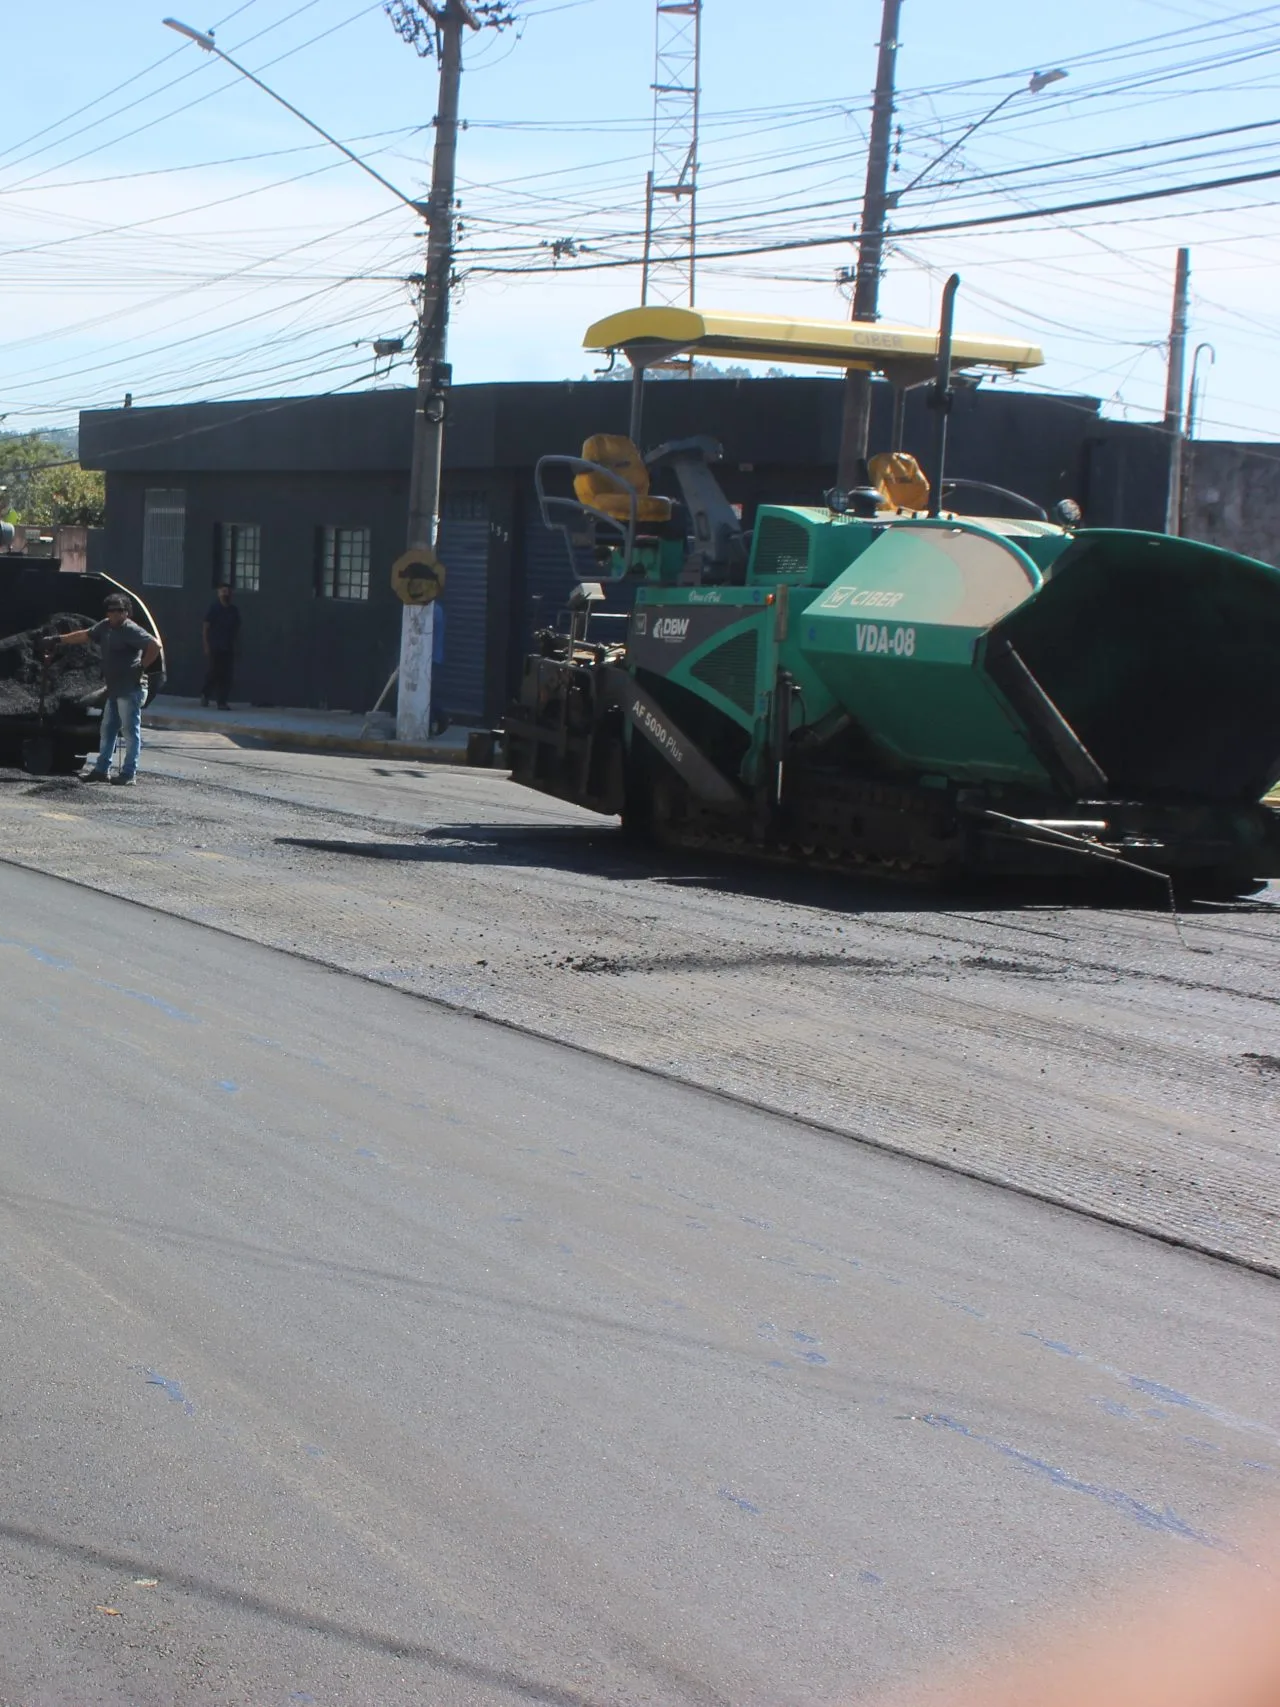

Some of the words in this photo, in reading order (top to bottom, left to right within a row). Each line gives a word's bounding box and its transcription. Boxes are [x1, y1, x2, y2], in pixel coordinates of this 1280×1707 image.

[853, 332, 903, 349] CIBER
[850, 590, 906, 608] CIBER
[856, 624, 916, 657] VDA-08
[632, 699, 646, 718] AF
[645, 713, 667, 743] 5000
[665, 736, 684, 763] Plus
